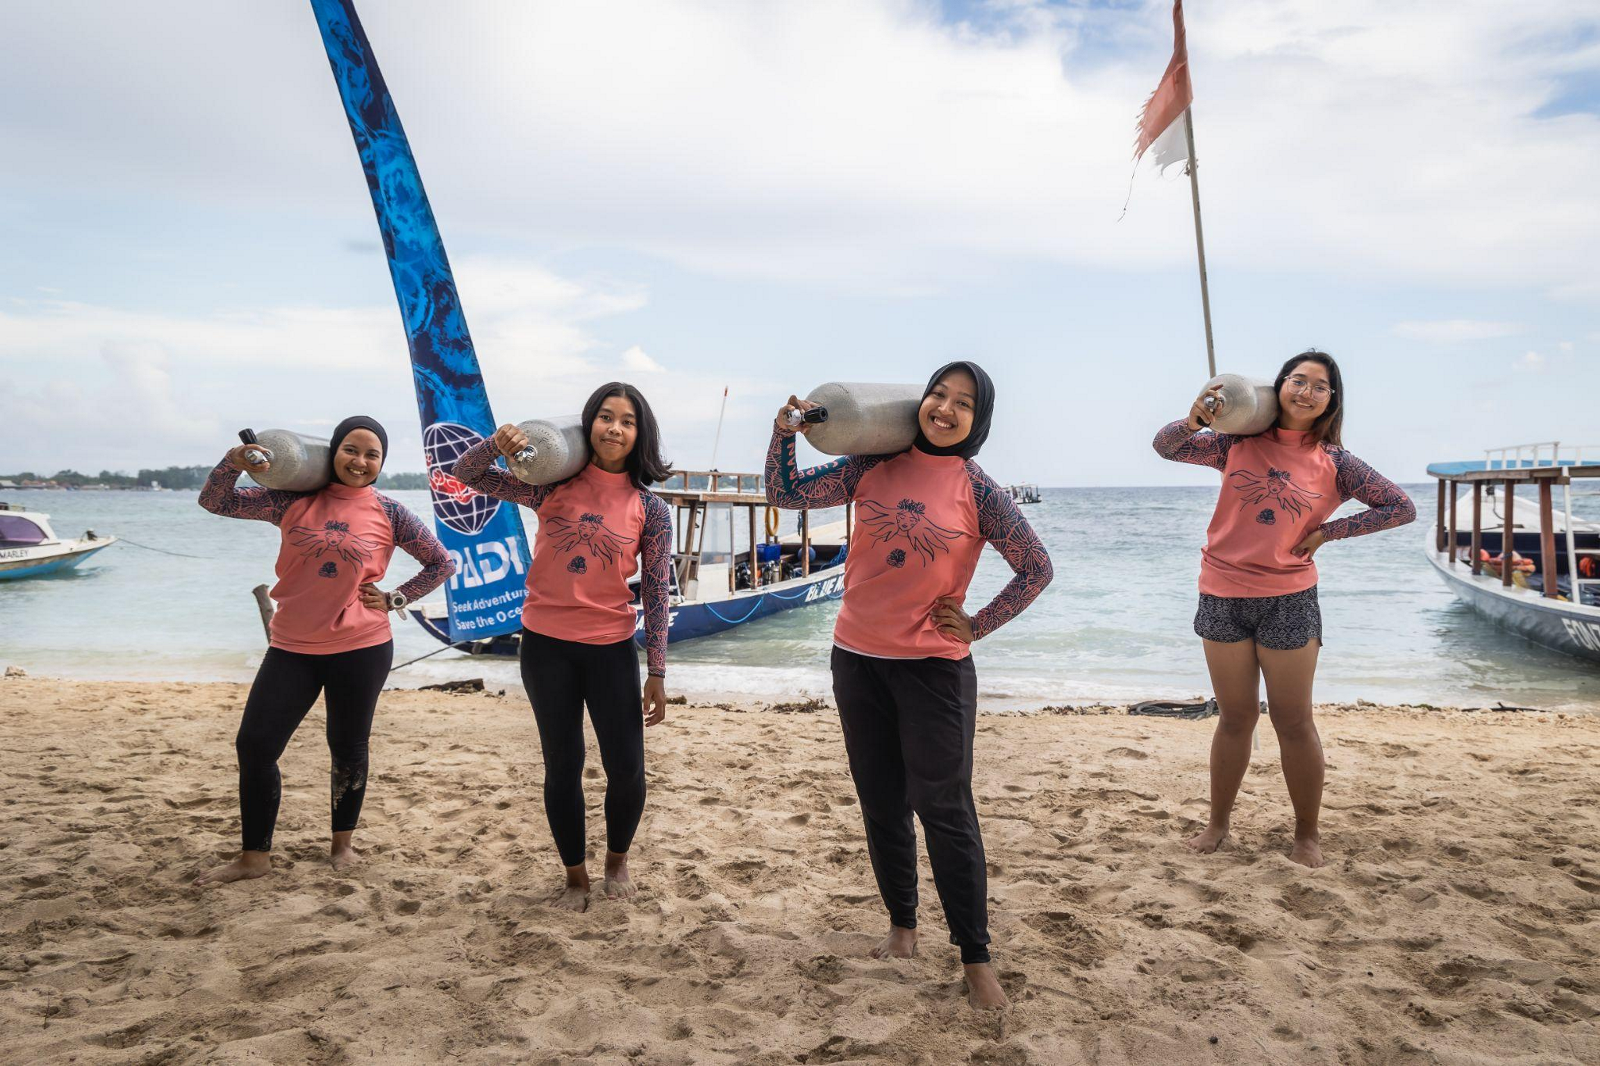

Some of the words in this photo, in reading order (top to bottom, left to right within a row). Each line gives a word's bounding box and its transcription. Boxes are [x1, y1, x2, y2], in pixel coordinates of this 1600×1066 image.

[448, 536, 525, 590] PADI
[452, 601, 473, 613] Seek
[473, 589, 530, 610] Adventure
[455, 618, 477, 631] Save
[476, 616, 495, 628] the
[496, 606, 524, 623] Oce
